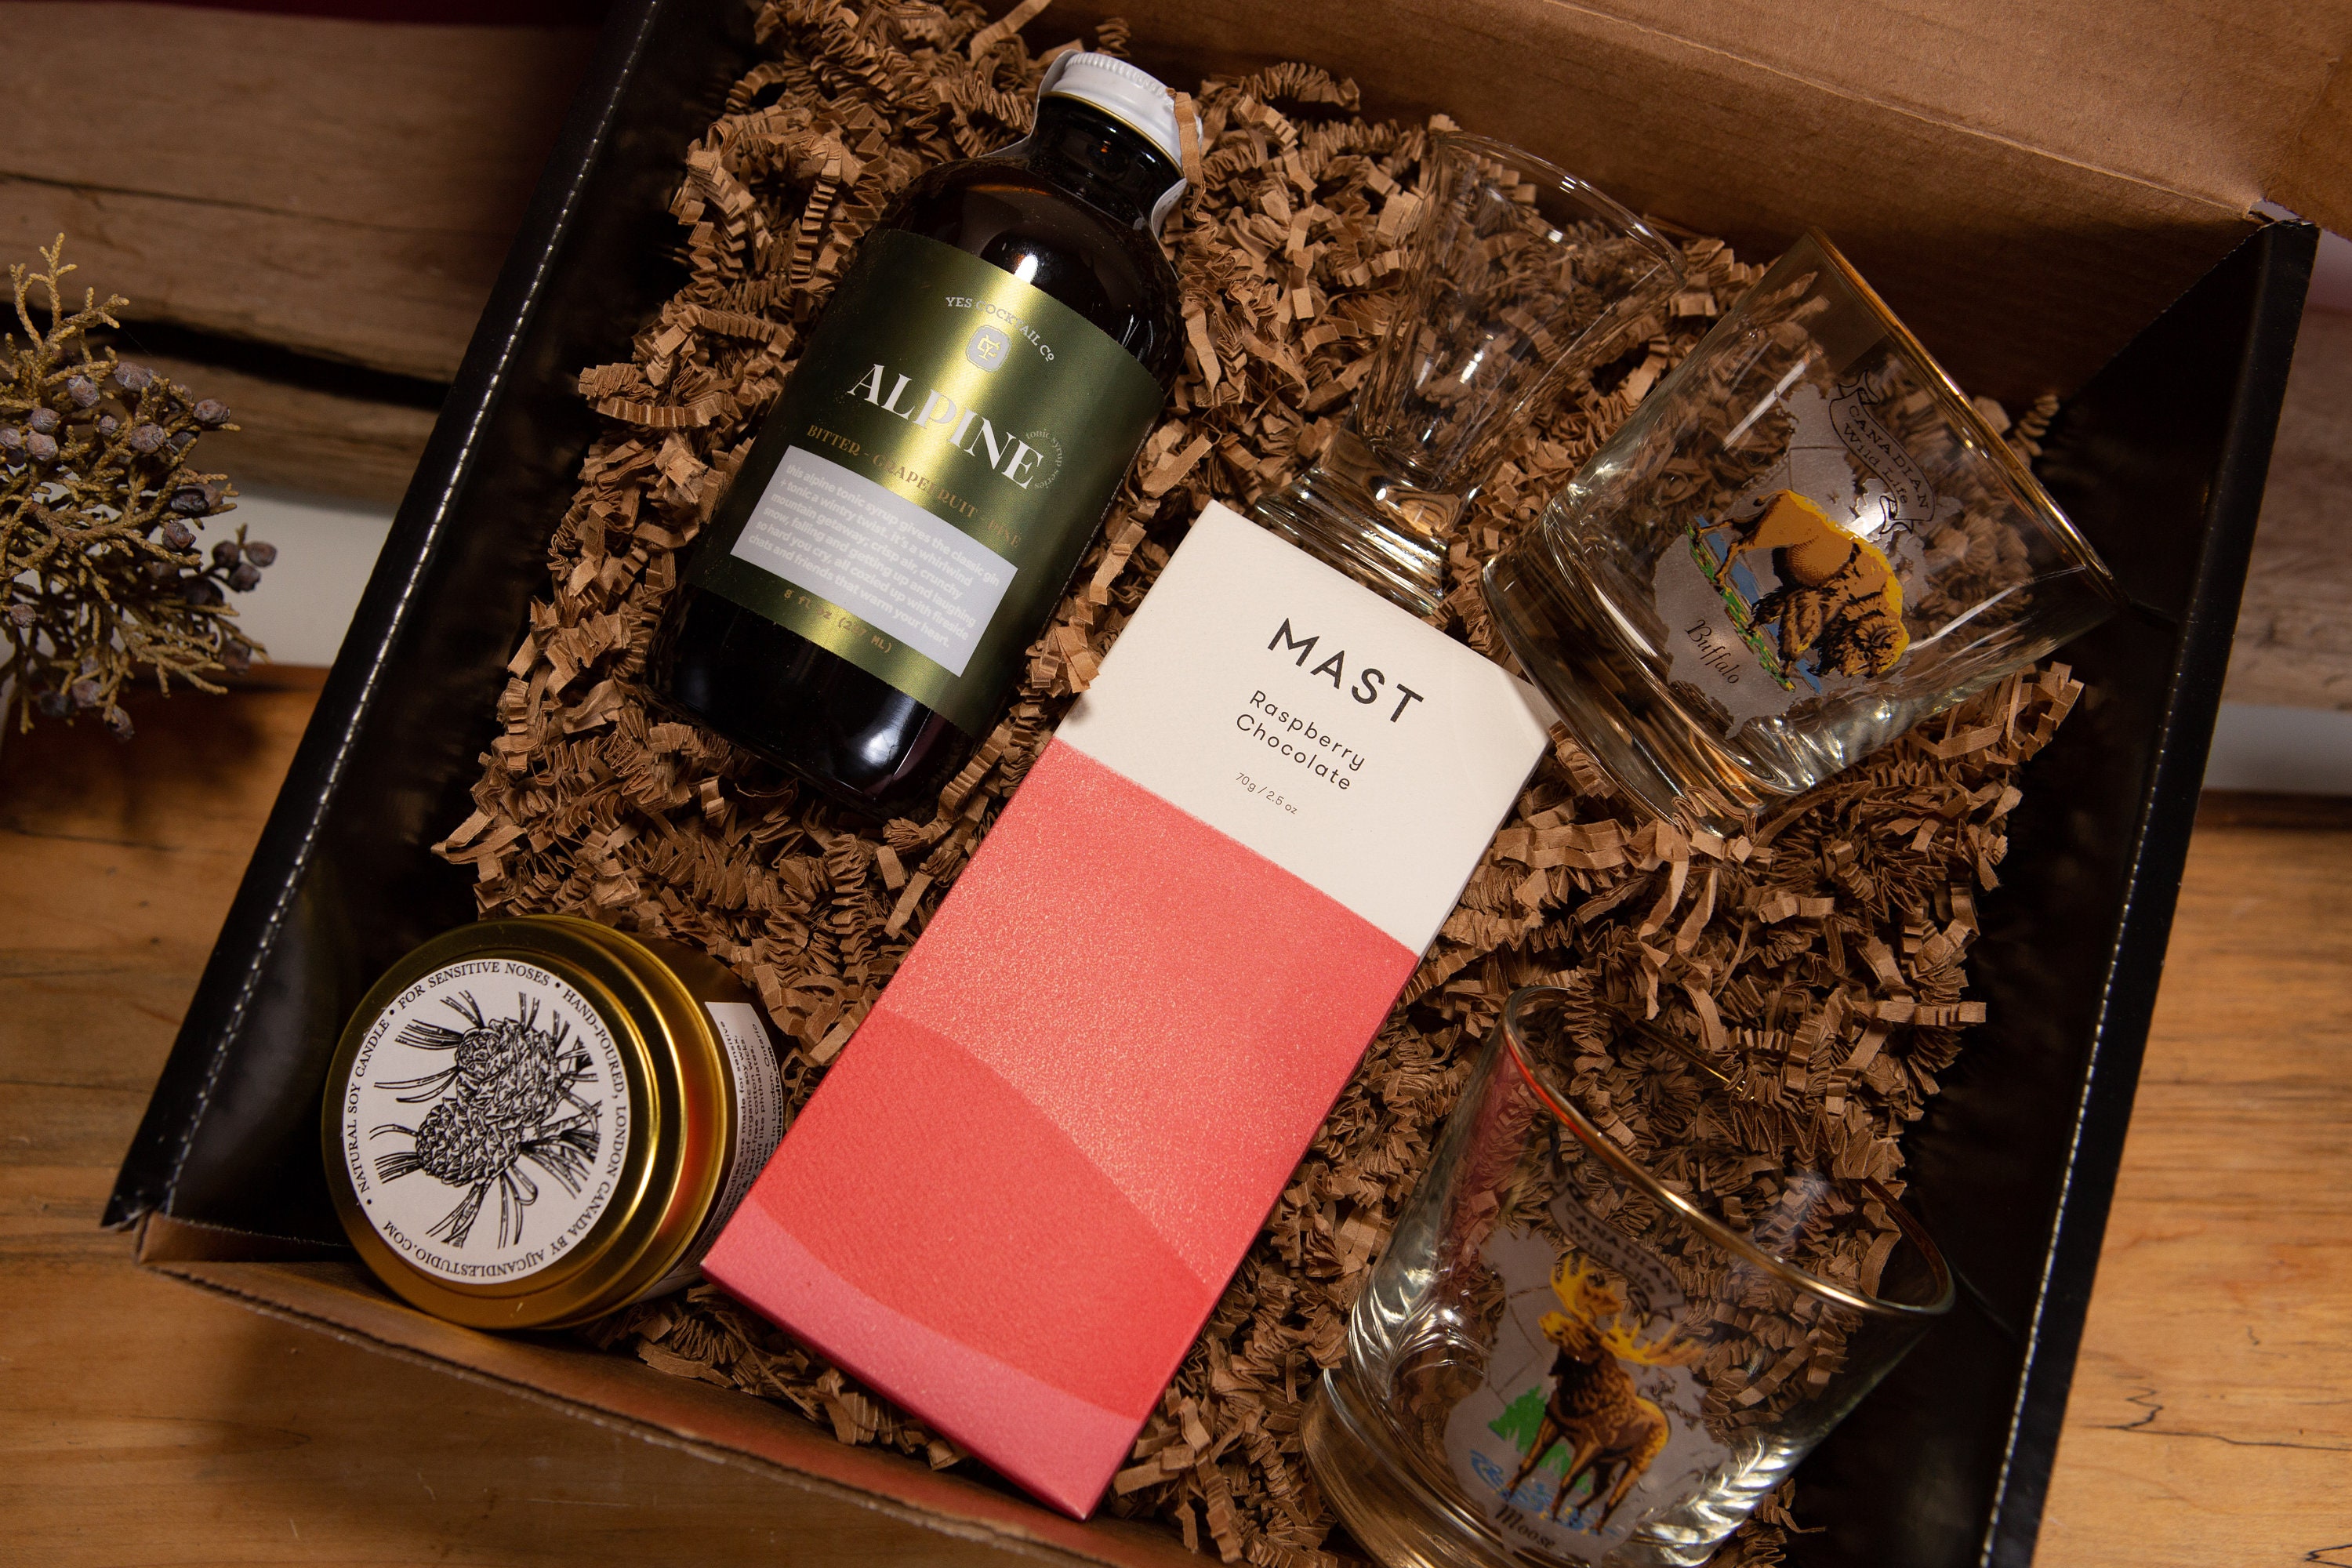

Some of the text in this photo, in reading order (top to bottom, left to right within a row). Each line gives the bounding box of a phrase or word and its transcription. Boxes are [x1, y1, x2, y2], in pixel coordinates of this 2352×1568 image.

[946, 296, 973, 308] YES
[976, 300, 1040, 347] COCKTAIL
[806, 424, 861, 457] BITTER
[846, 363, 1044, 491] ALPINE
[1025, 428, 1051, 440] tonic
[1849, 405, 1929, 509] CANADIAN
[1844, 423, 1908, 504] Wild Life
[770, 488, 818, 521] mountain
[868, 539, 901, 564] crisp
[898, 554, 921, 574] air,
[916, 566, 965, 601] crunchy
[785, 462, 1002, 588] this alpine tonic syrup gives the classic gin
[785, 479, 813, 500] tonic
[810, 493, 820, 503] a
[818, 495, 857, 523] wintry
[855, 514, 891, 539] twist.
[908, 543, 918, 554] a
[914, 546, 975, 587] whirlwind
[747, 531, 953, 648] chats and friends that warm your heart.
[754, 519, 972, 641] so hard you cry, all cozied up with fireside
[761, 504, 979, 629] snow, falling and getting up and laughing
[784, 589, 793, 599] 8
[798, 595, 811, 609] fl
[870, 635, 892, 653] ML)
[1685, 619, 1740, 684] Buffalo
[1267, 617, 1425, 724] MAST
[1236, 713, 1351, 791] Chocolate
[1250, 690, 1366, 771] Raspberry
[1236, 772, 1258, 793] 70g
[1265, 789, 1285, 807] 2.5
[1284, 802, 1298, 815] oz
[397, 961, 551, 1011] FOR SENSITIVE NOSES
[562, 989, 626, 1100] HAND-POURED,
[720, 1021, 741, 1073] sensitive
[742, 1064, 750, 1086] soy
[753, 1023, 770, 1067] Ontario
[347, 1018, 390, 1194] NATURAL SOY CANDLE
[750, 1074, 759, 1116] cotton
[606, 1105, 627, 1179] LONDON
[739, 1158, 748, 1179] mix
[746, 1141, 751, 1153] of
[746, 1119, 759, 1176] lead-free
[567, 1181, 611, 1237] CANADA
[550, 1235, 568, 1257] BY
[1494, 1504, 1556, 1548] Moose
